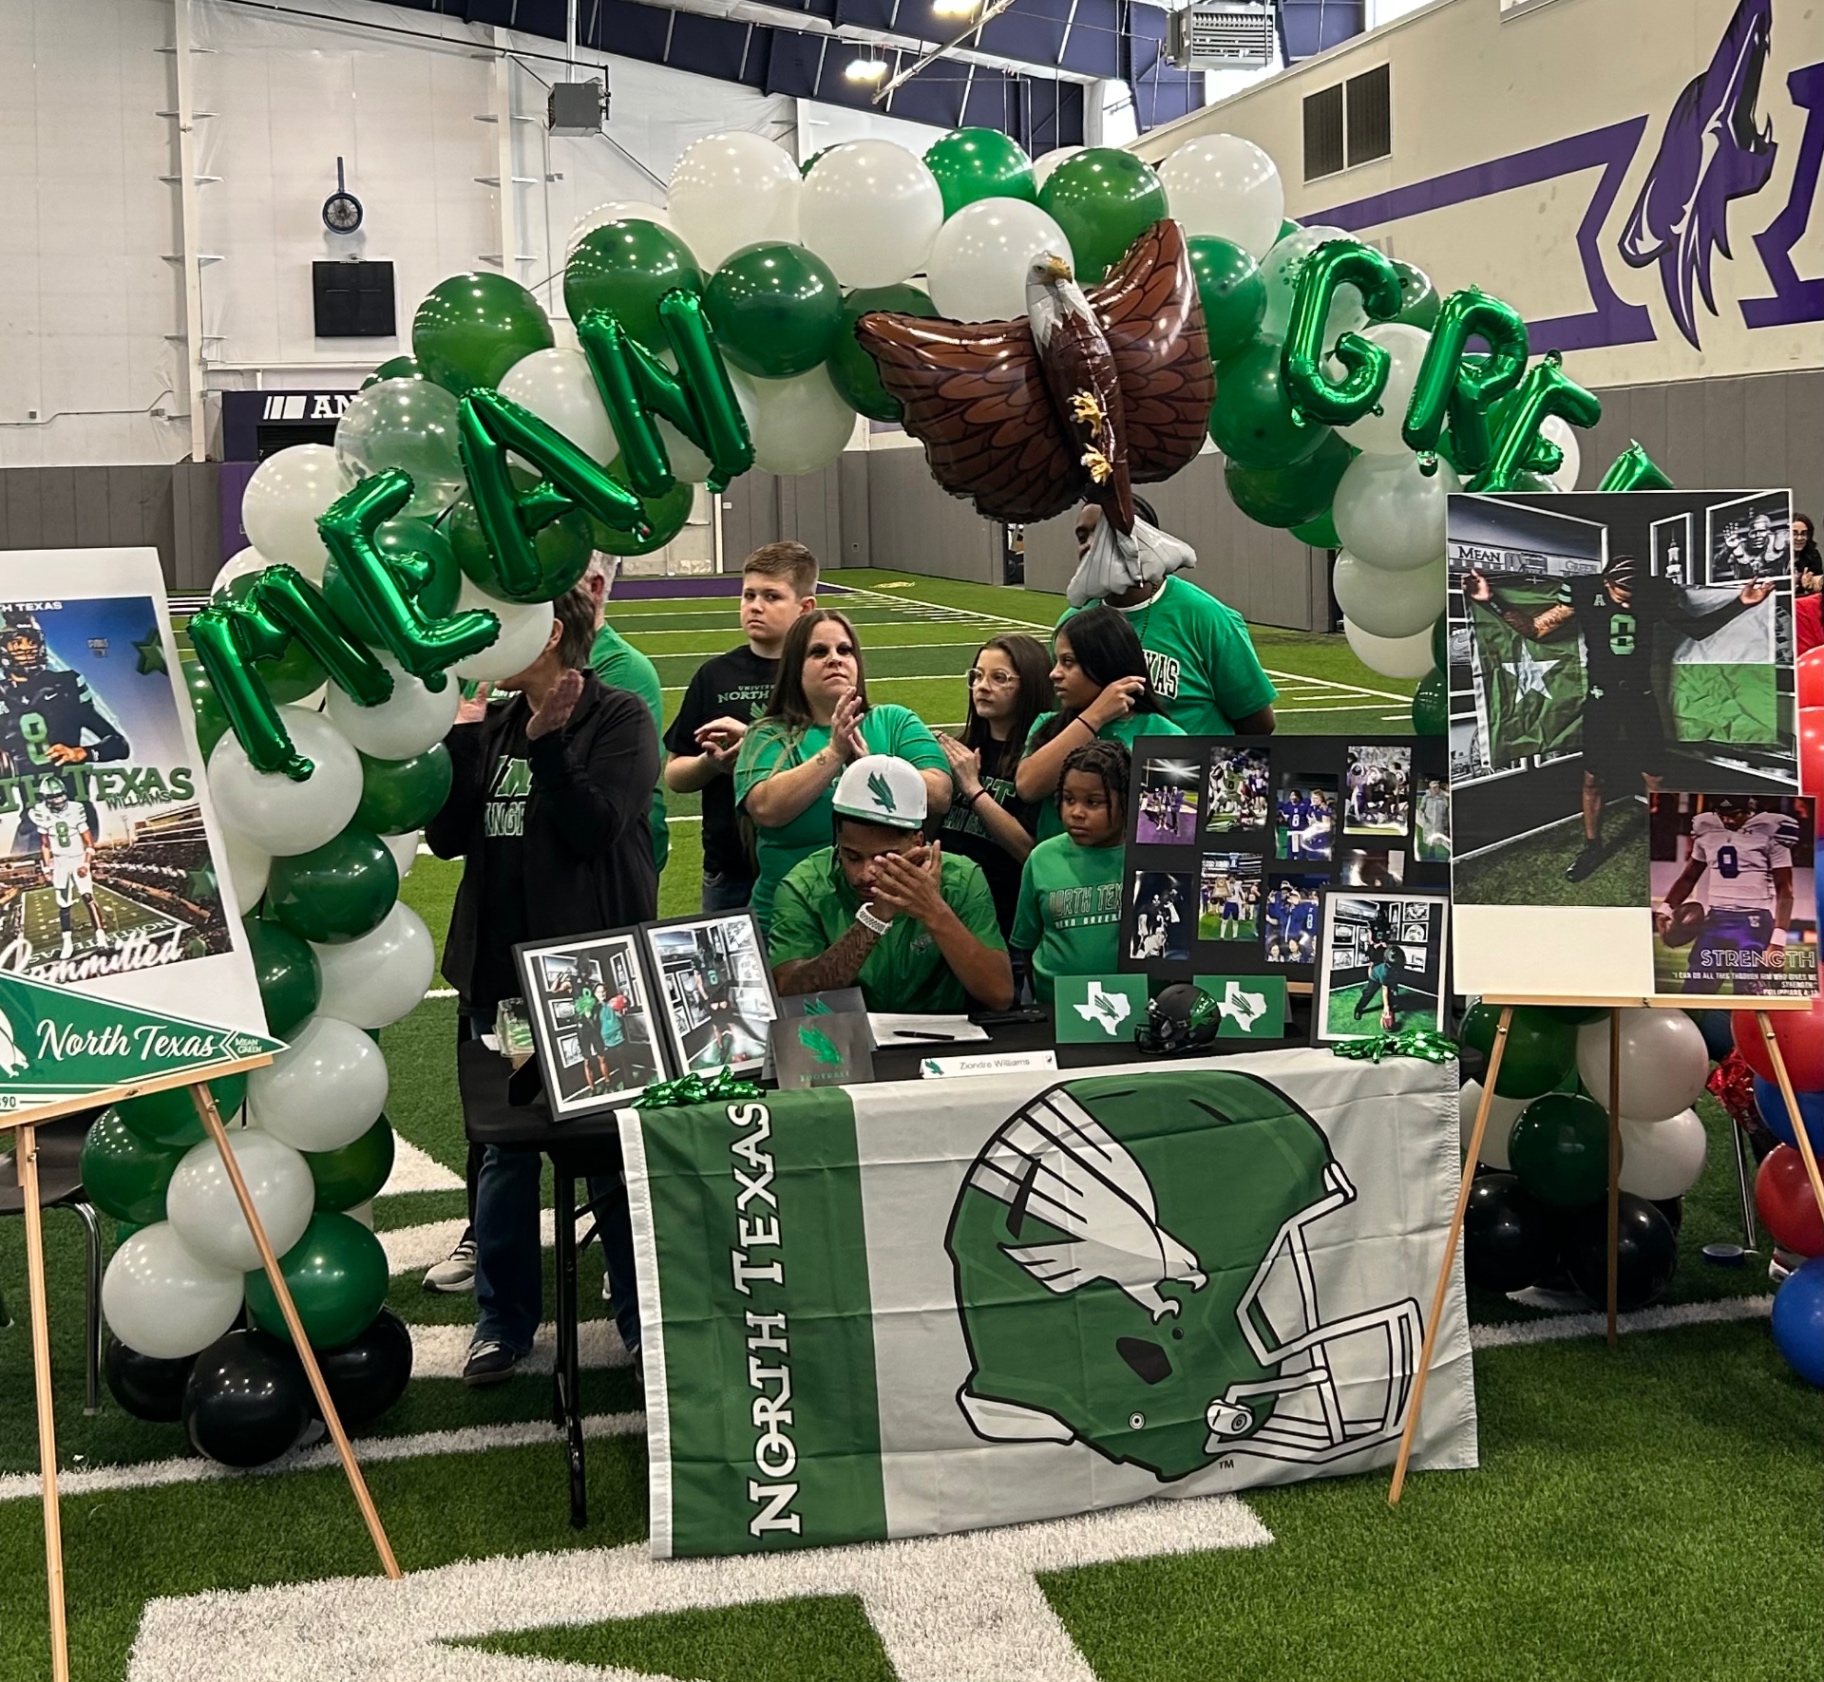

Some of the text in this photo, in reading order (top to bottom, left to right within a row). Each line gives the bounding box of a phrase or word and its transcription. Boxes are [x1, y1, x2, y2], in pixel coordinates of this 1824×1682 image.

[188, 286, 756, 782] MEAN
[1458, 546, 1500, 562] MEAN
[15, 601, 63, 612] TEXAS
[717, 690, 770, 704] NORTH
[61, 764, 195, 802] TEXAS
[1700, 949, 1816, 968] STRENGTH
[1703, 971, 1715, 980] ALL
[36, 1018, 219, 1063] North Texas
[728, 1103, 803, 1539] NORTH TEXAS
